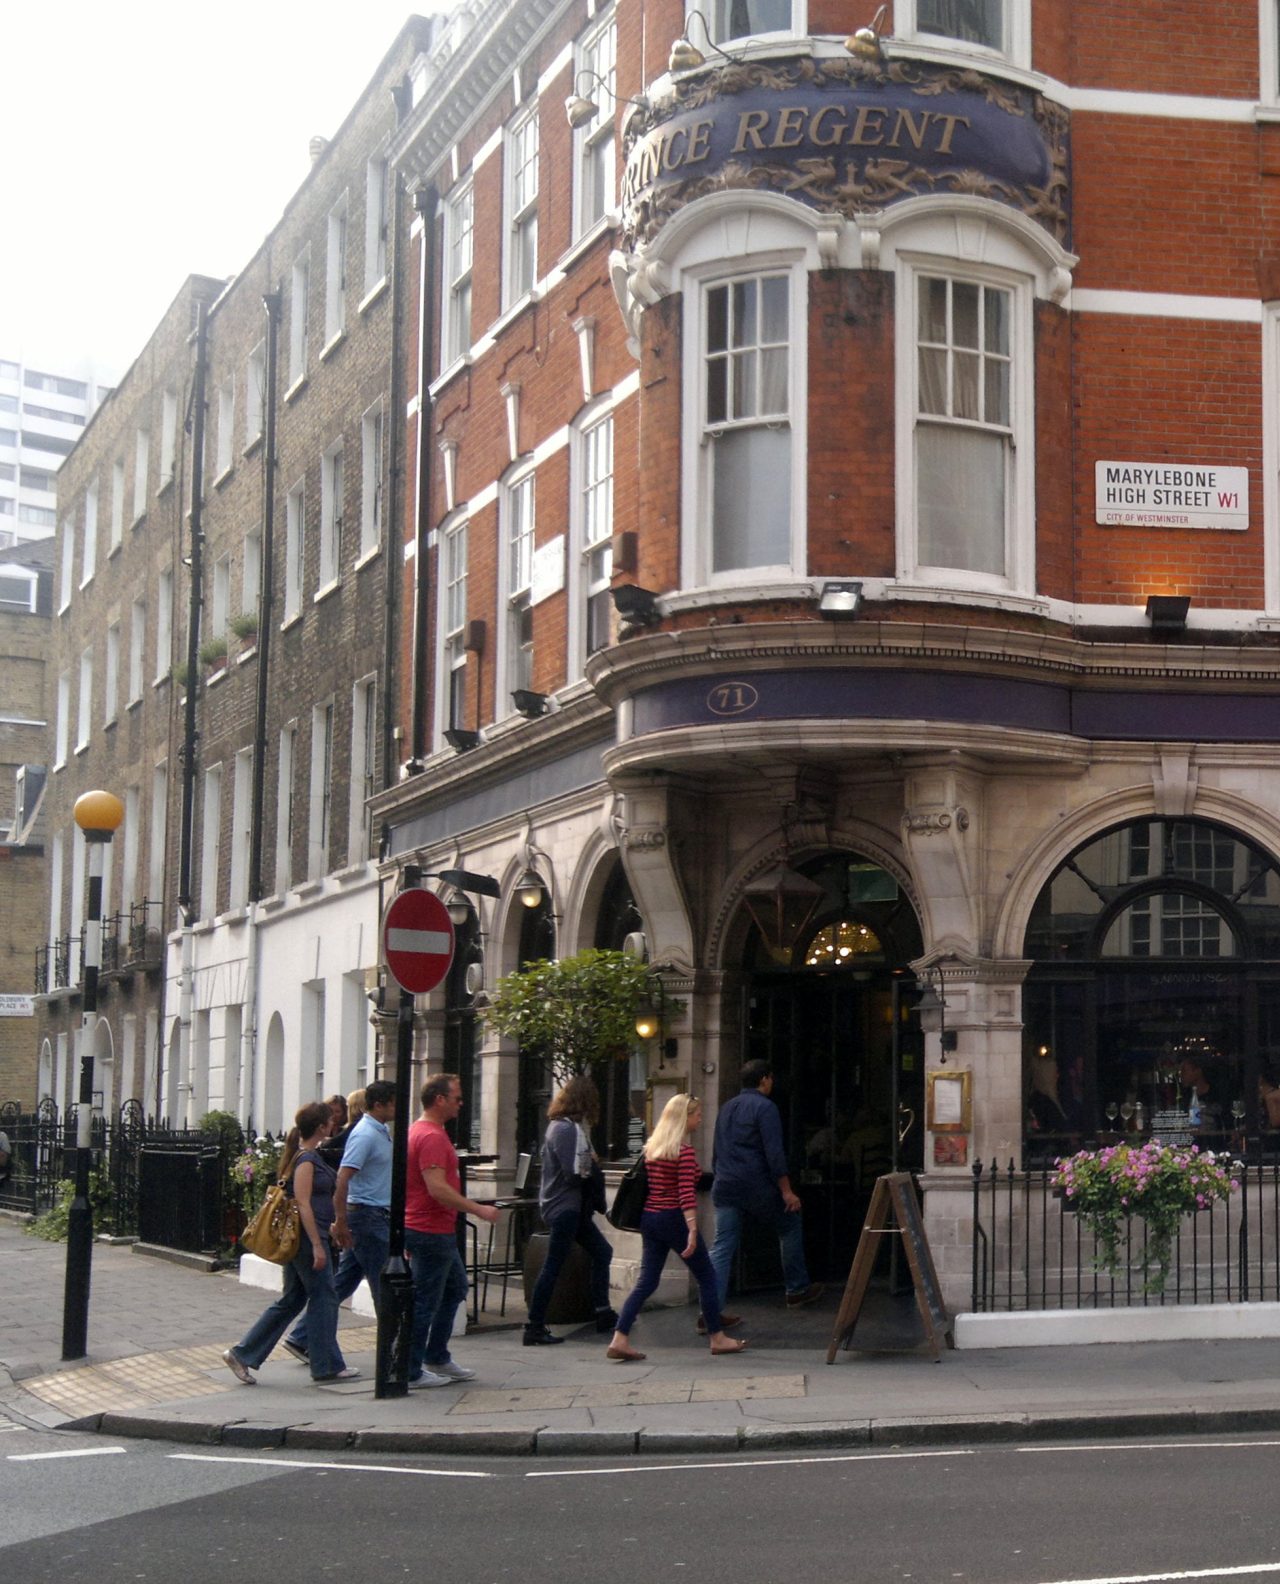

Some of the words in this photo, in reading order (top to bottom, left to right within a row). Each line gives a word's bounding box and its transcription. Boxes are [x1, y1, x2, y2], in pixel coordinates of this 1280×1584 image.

[621, 120, 714, 216] PRINCE
[731, 106, 970, 154] REGENT
[1106, 467, 1216, 488] MARYLEBONE
[1106, 487, 1146, 504] HIGH
[1153, 489, 1211, 507] STREET
[1217, 492, 1238, 509] W1
[1106, 513, 1124, 521] CITY
[1125, 513, 1135, 521] OF
[1137, 514, 1189, 524] WESTMINSTER
[717, 688, 745, 708] 71
